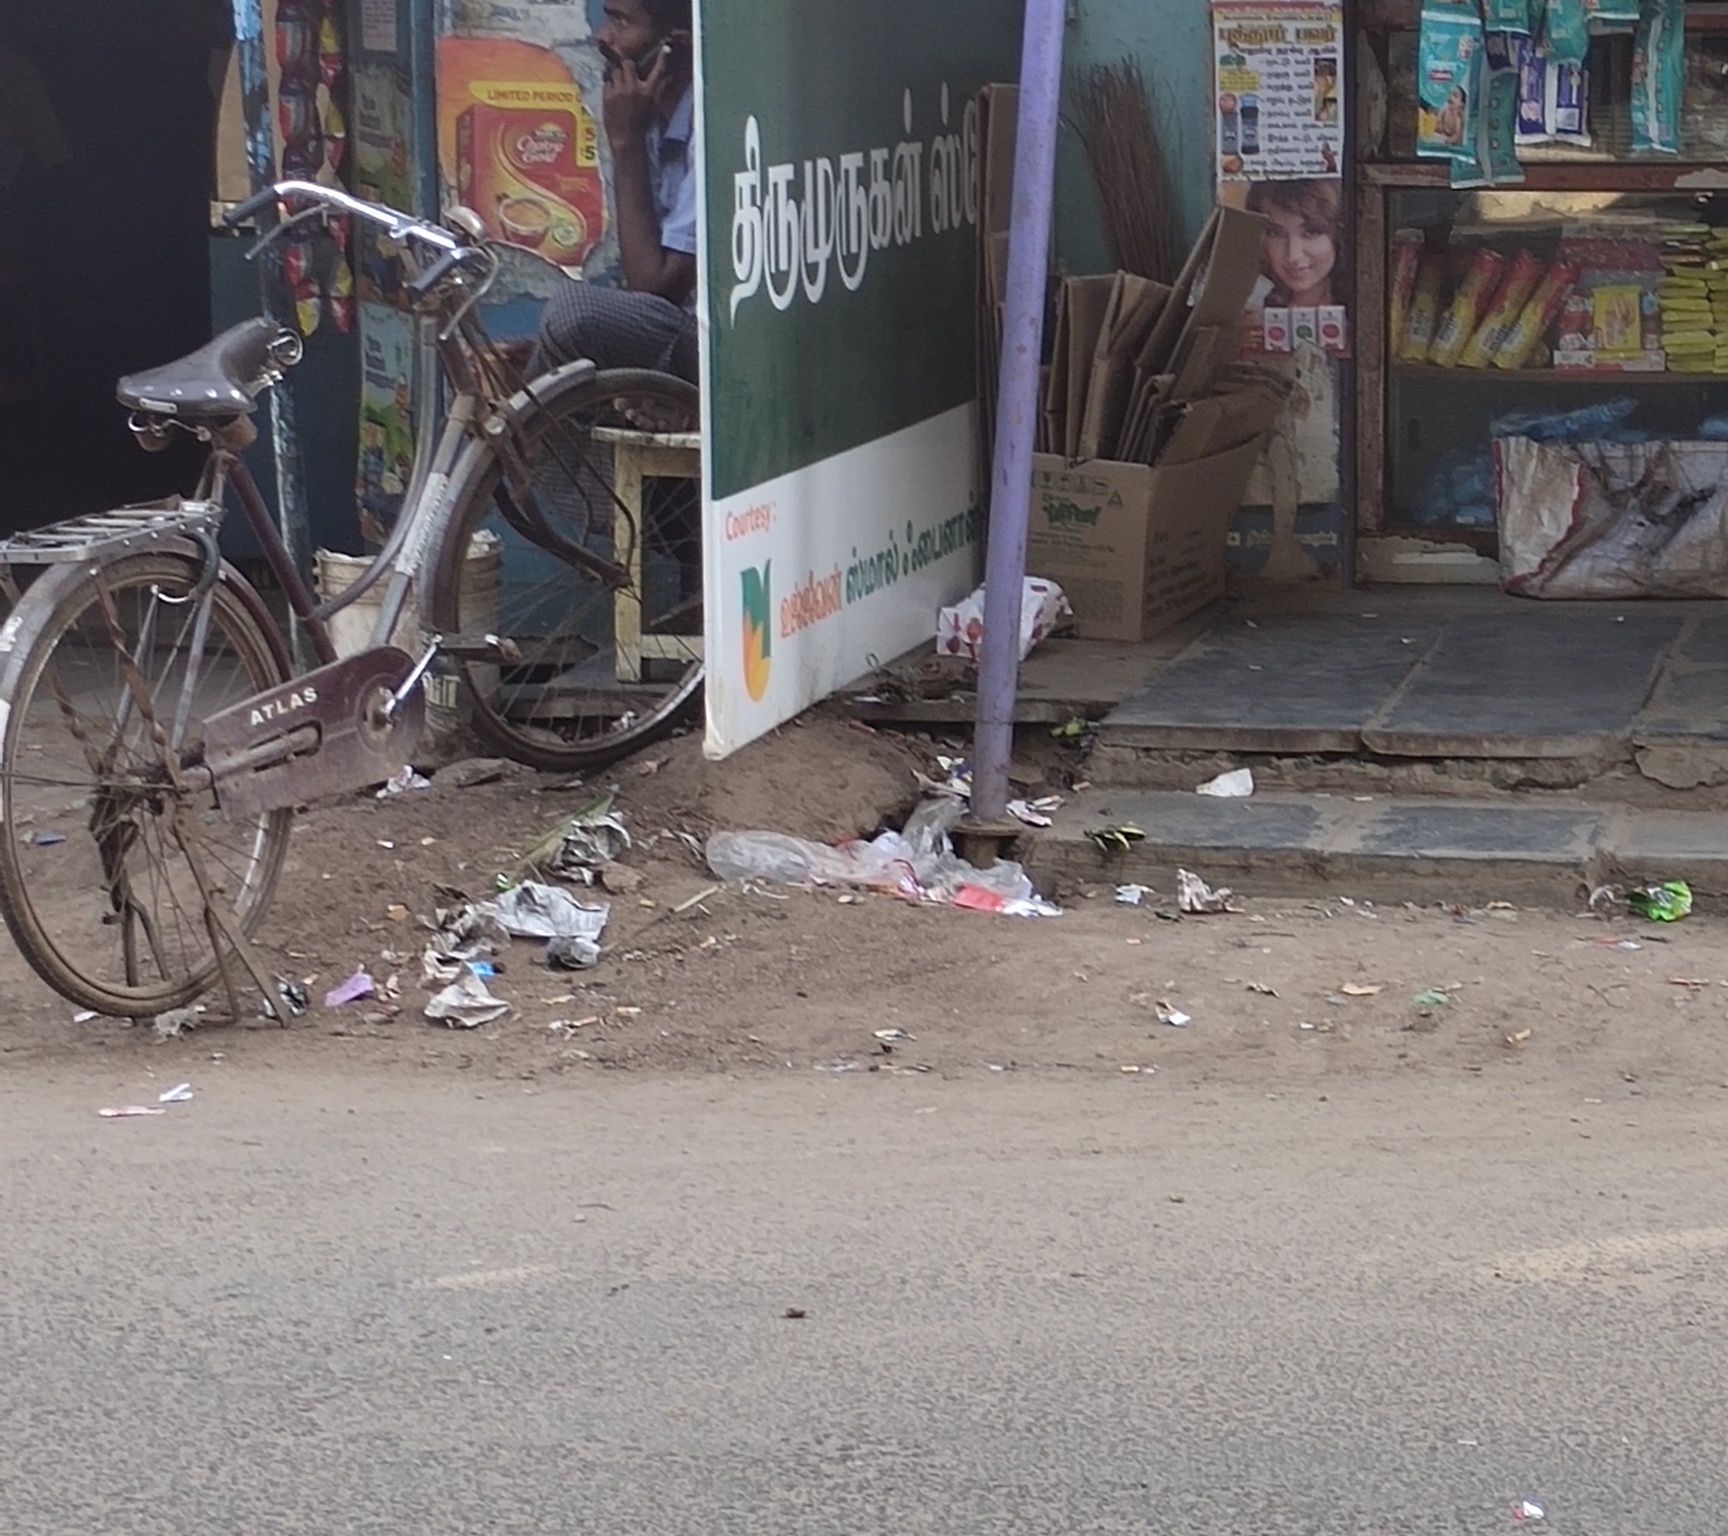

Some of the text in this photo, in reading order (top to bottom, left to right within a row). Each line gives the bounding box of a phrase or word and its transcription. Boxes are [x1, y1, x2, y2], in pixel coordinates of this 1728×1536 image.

[487, 89, 574, 103] LIMITED PERIOD
[730, 88, 923, 331] திருமுருகன்
[250, 686, 319, 727] ATLAS
